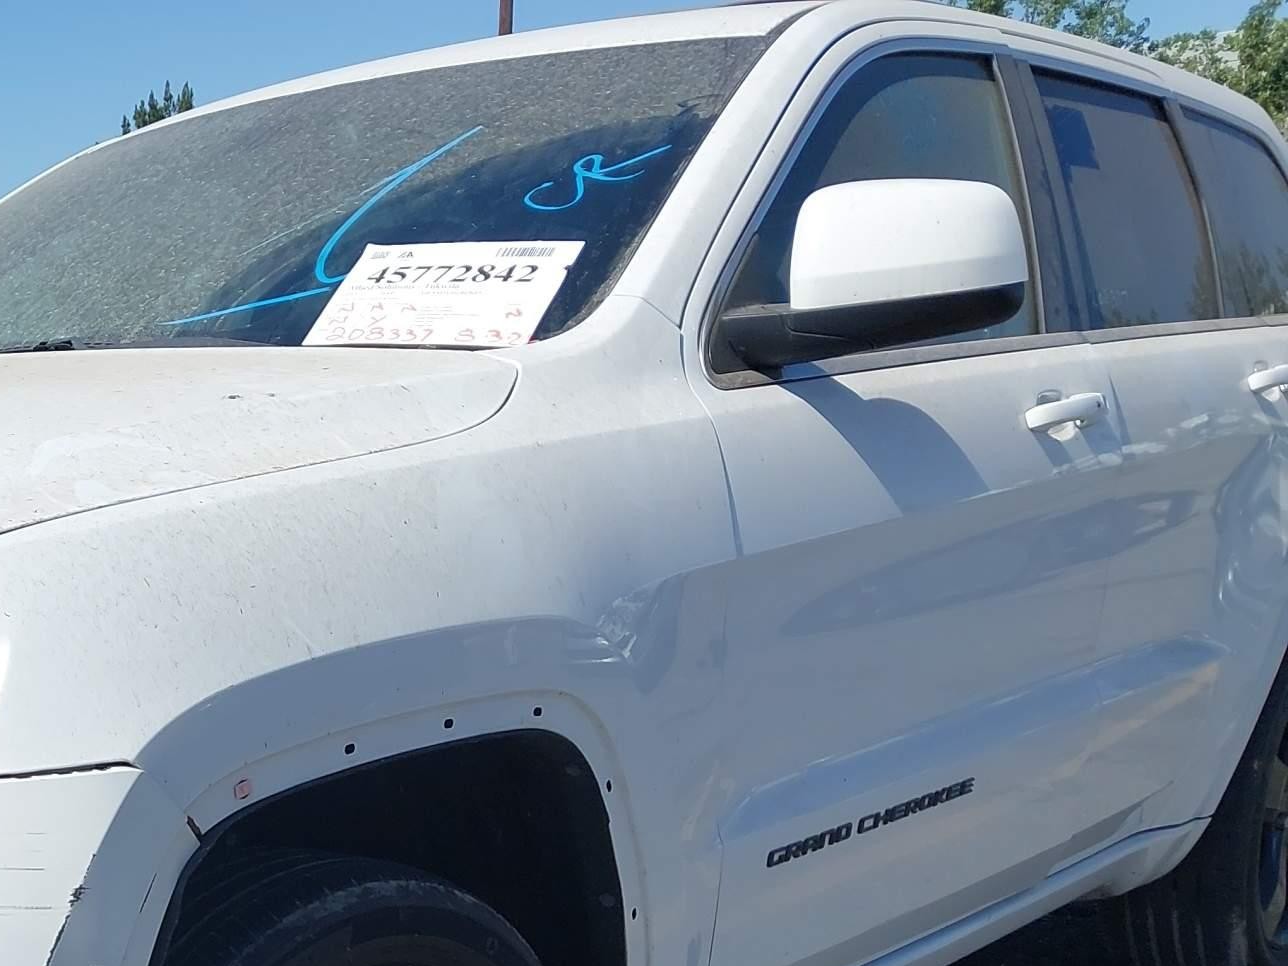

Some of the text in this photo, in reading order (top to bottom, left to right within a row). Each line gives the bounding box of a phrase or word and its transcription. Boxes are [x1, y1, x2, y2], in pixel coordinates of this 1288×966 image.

[367, 264, 540, 285] 45772842
[766, 777, 976, 868] GRAND CHEROKEE
